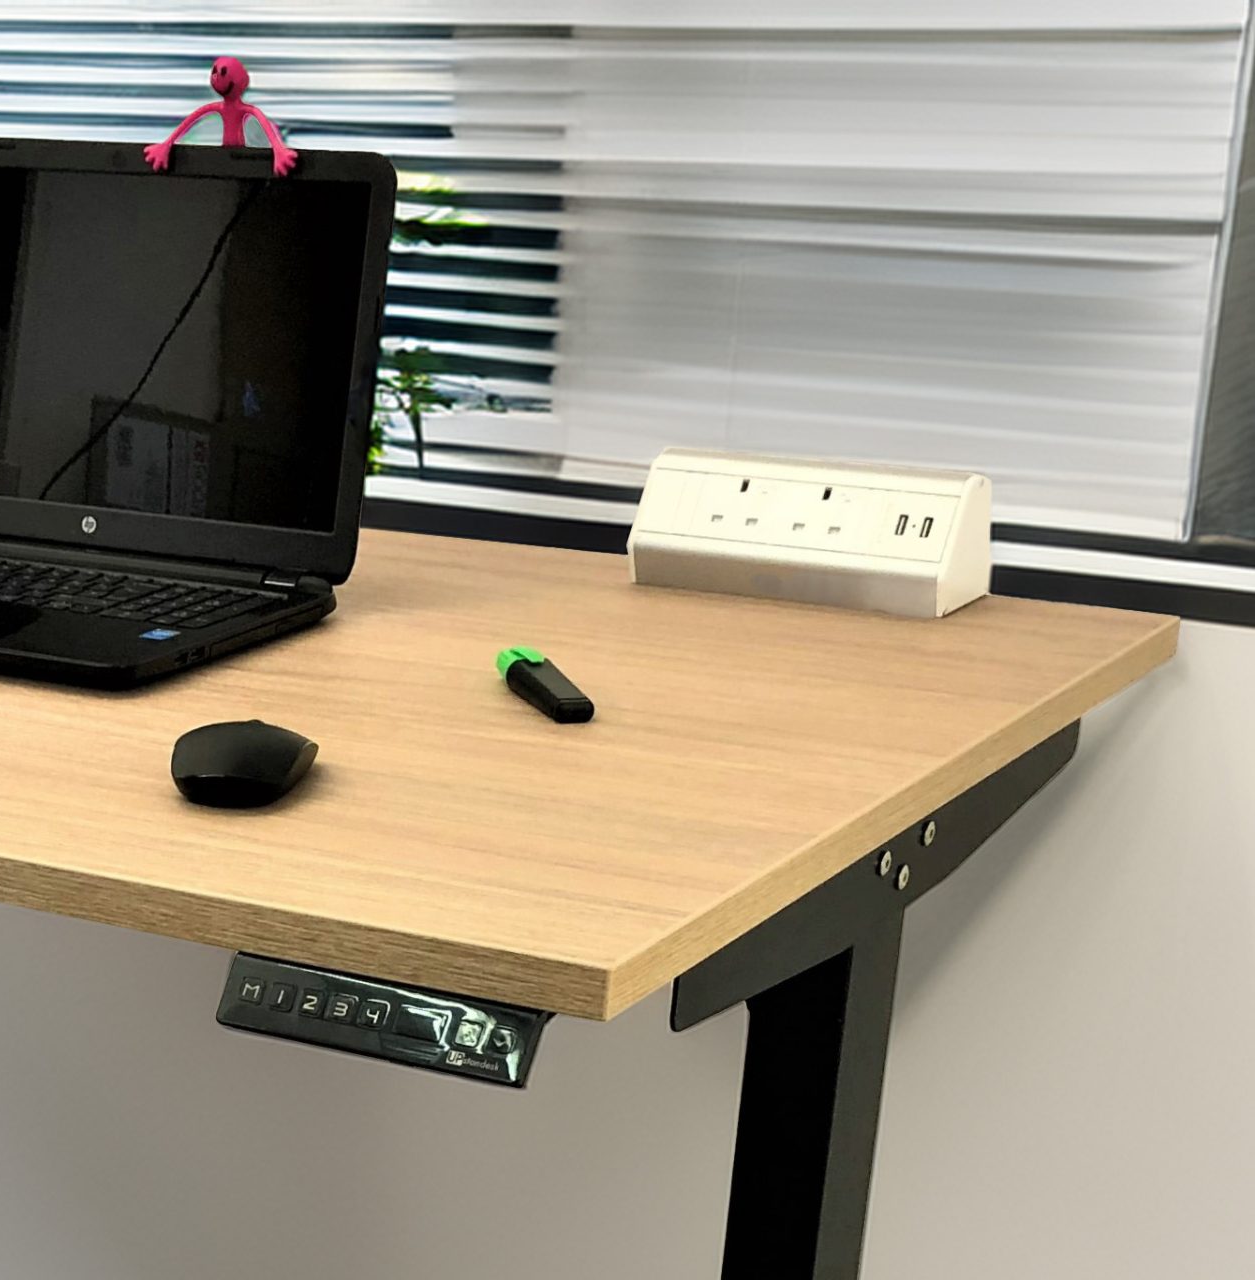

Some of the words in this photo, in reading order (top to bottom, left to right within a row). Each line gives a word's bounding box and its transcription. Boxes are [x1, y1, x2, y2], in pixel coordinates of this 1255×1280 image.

[83, 516, 95, 533] hp
[242, 983, 260, 998] M
[302, 995, 318, 1010] 2
[333, 1002, 349, 1017] 3
[366, 1008, 380, 1024] 4
